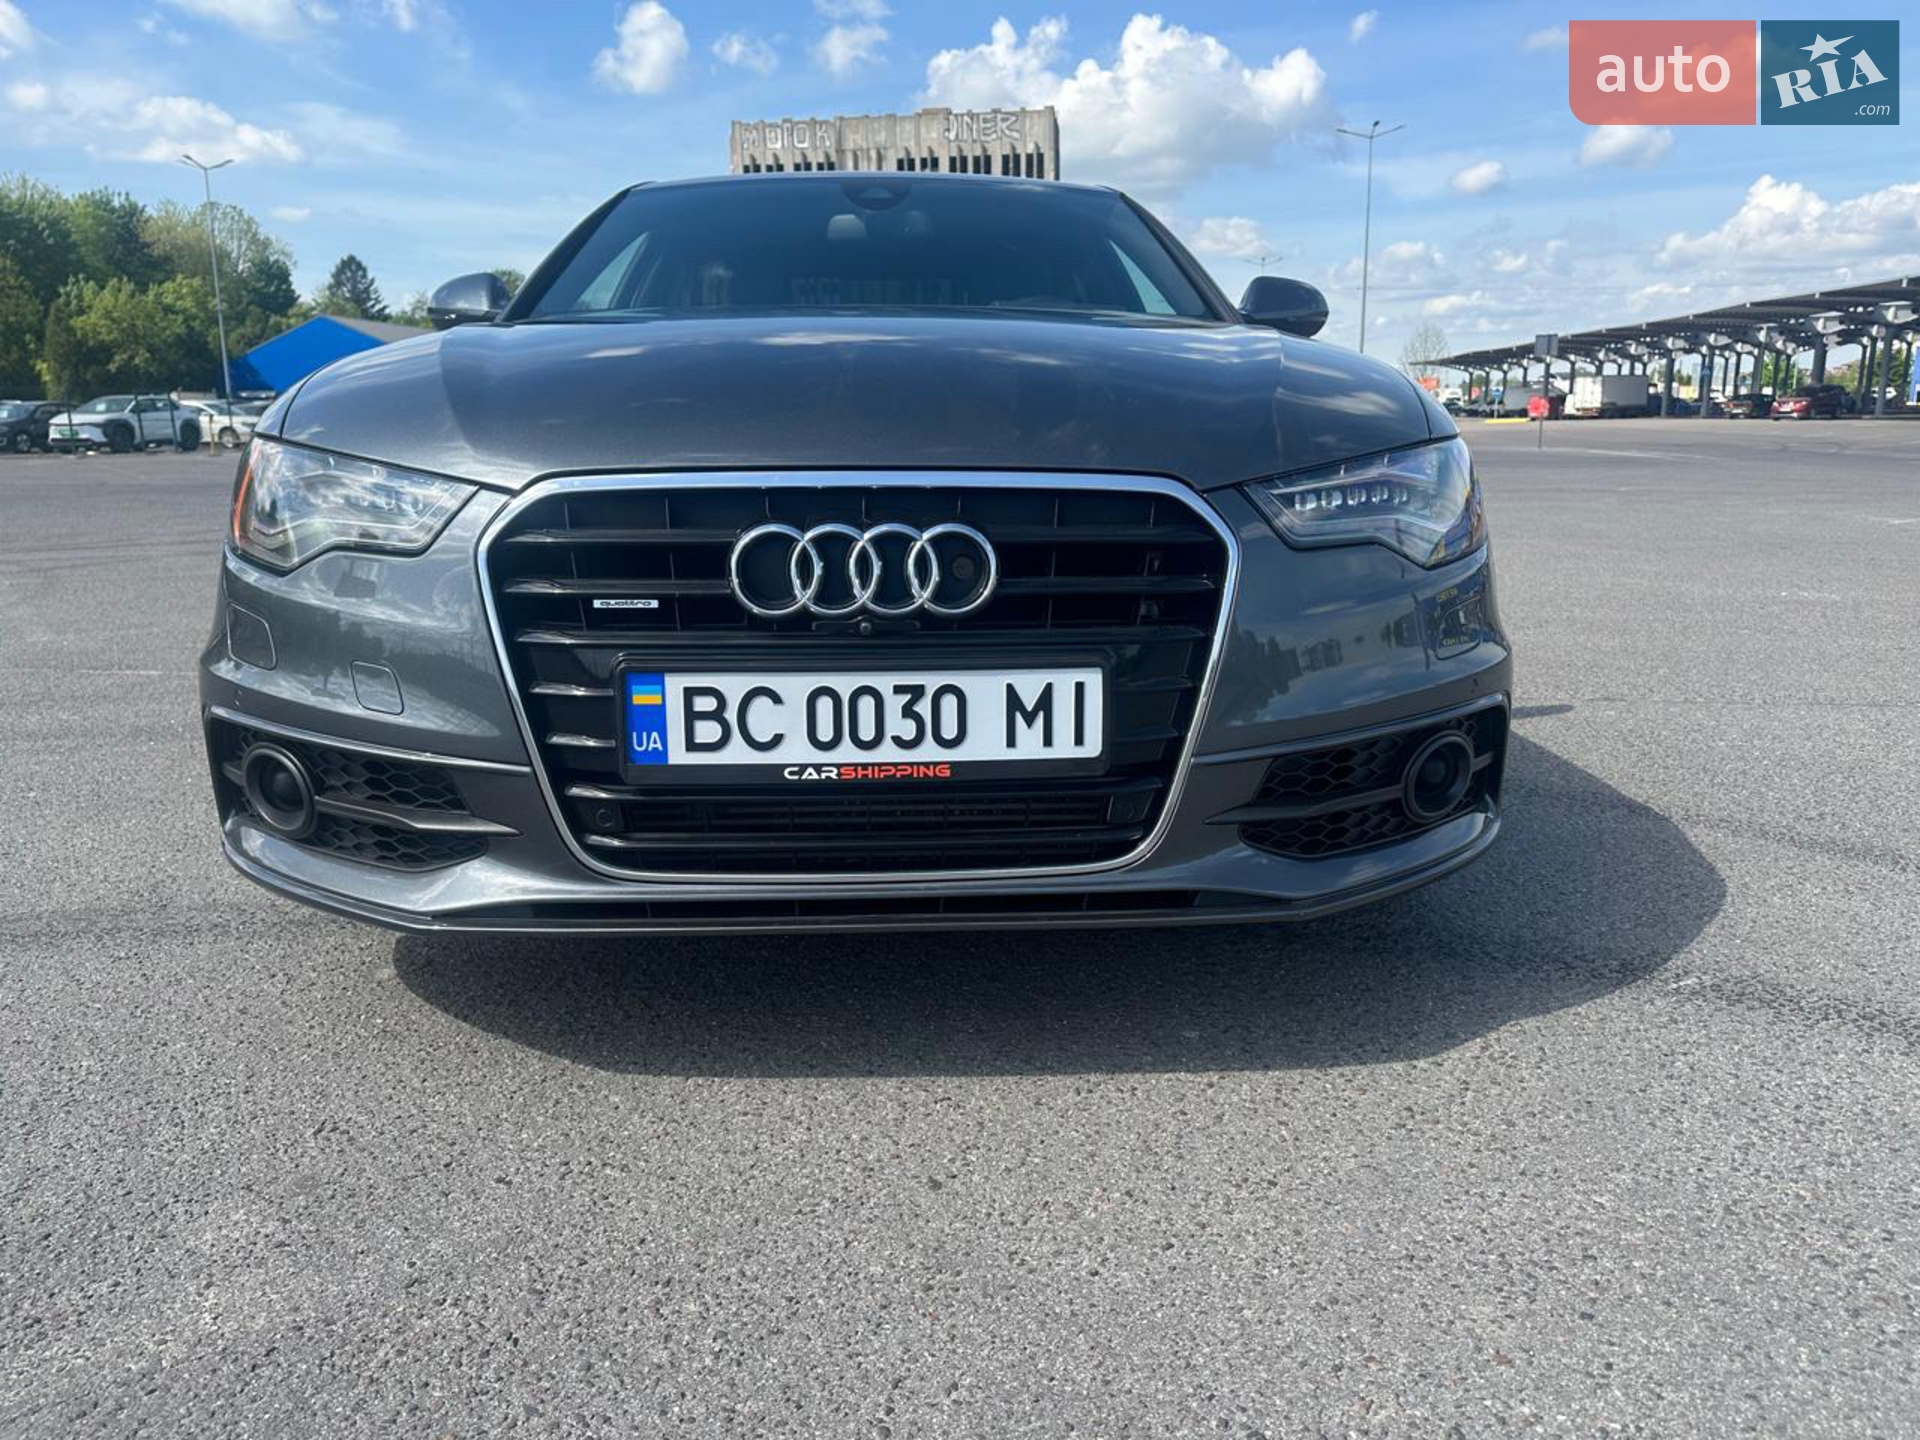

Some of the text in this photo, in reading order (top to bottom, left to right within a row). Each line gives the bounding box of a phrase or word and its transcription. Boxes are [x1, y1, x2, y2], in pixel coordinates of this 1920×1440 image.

[599, 600, 652, 609] quattro
[632, 680, 1086, 753] UA BC 0030 MI
[783, 763, 951, 780] CARSHIPPING
